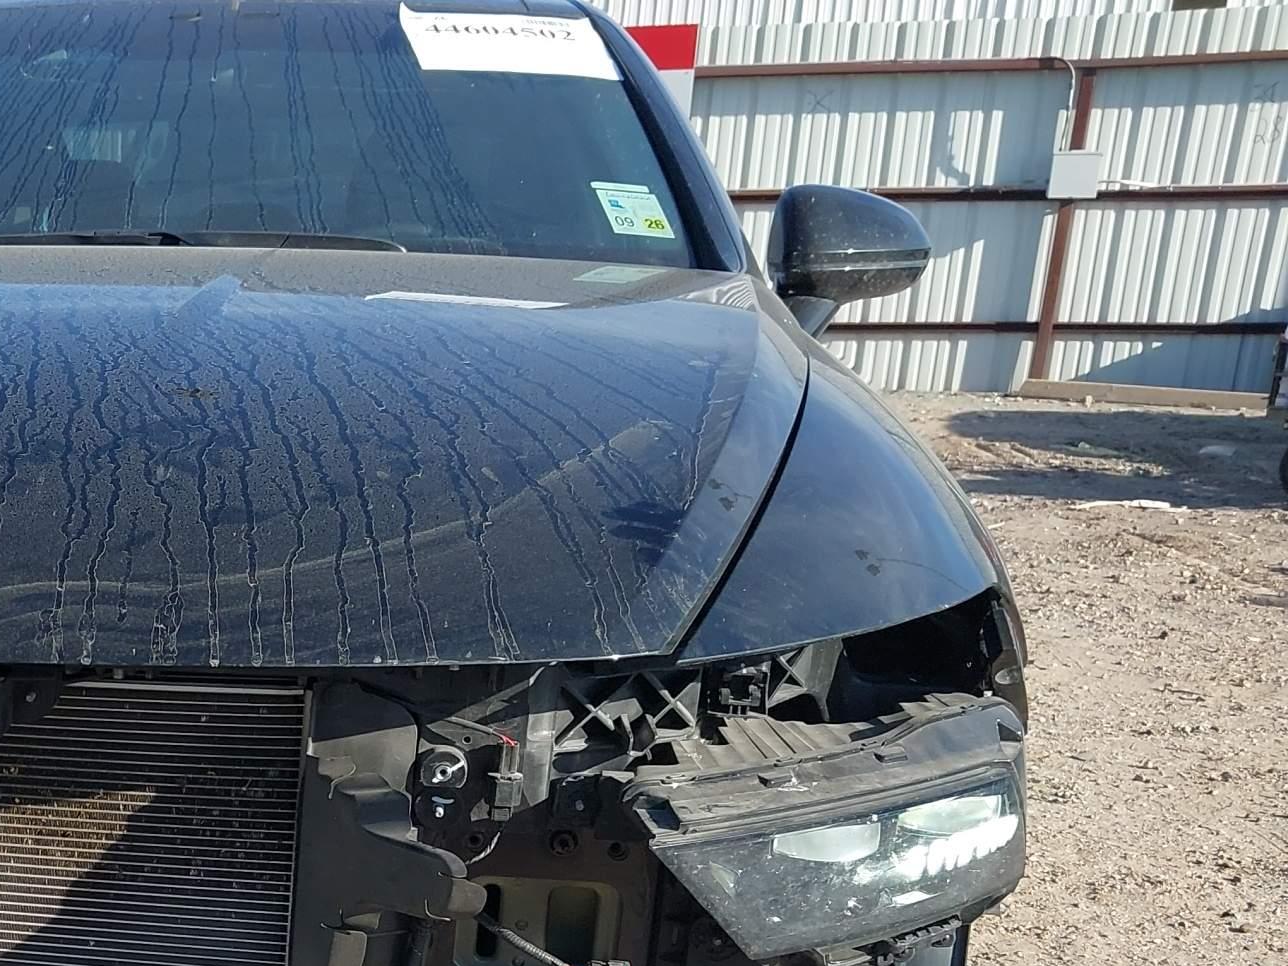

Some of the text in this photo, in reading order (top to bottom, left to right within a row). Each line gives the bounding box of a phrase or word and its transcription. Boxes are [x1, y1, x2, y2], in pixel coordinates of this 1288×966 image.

[425, 23, 576, 41] 44604502
[614, 215, 665, 230] 09 26
